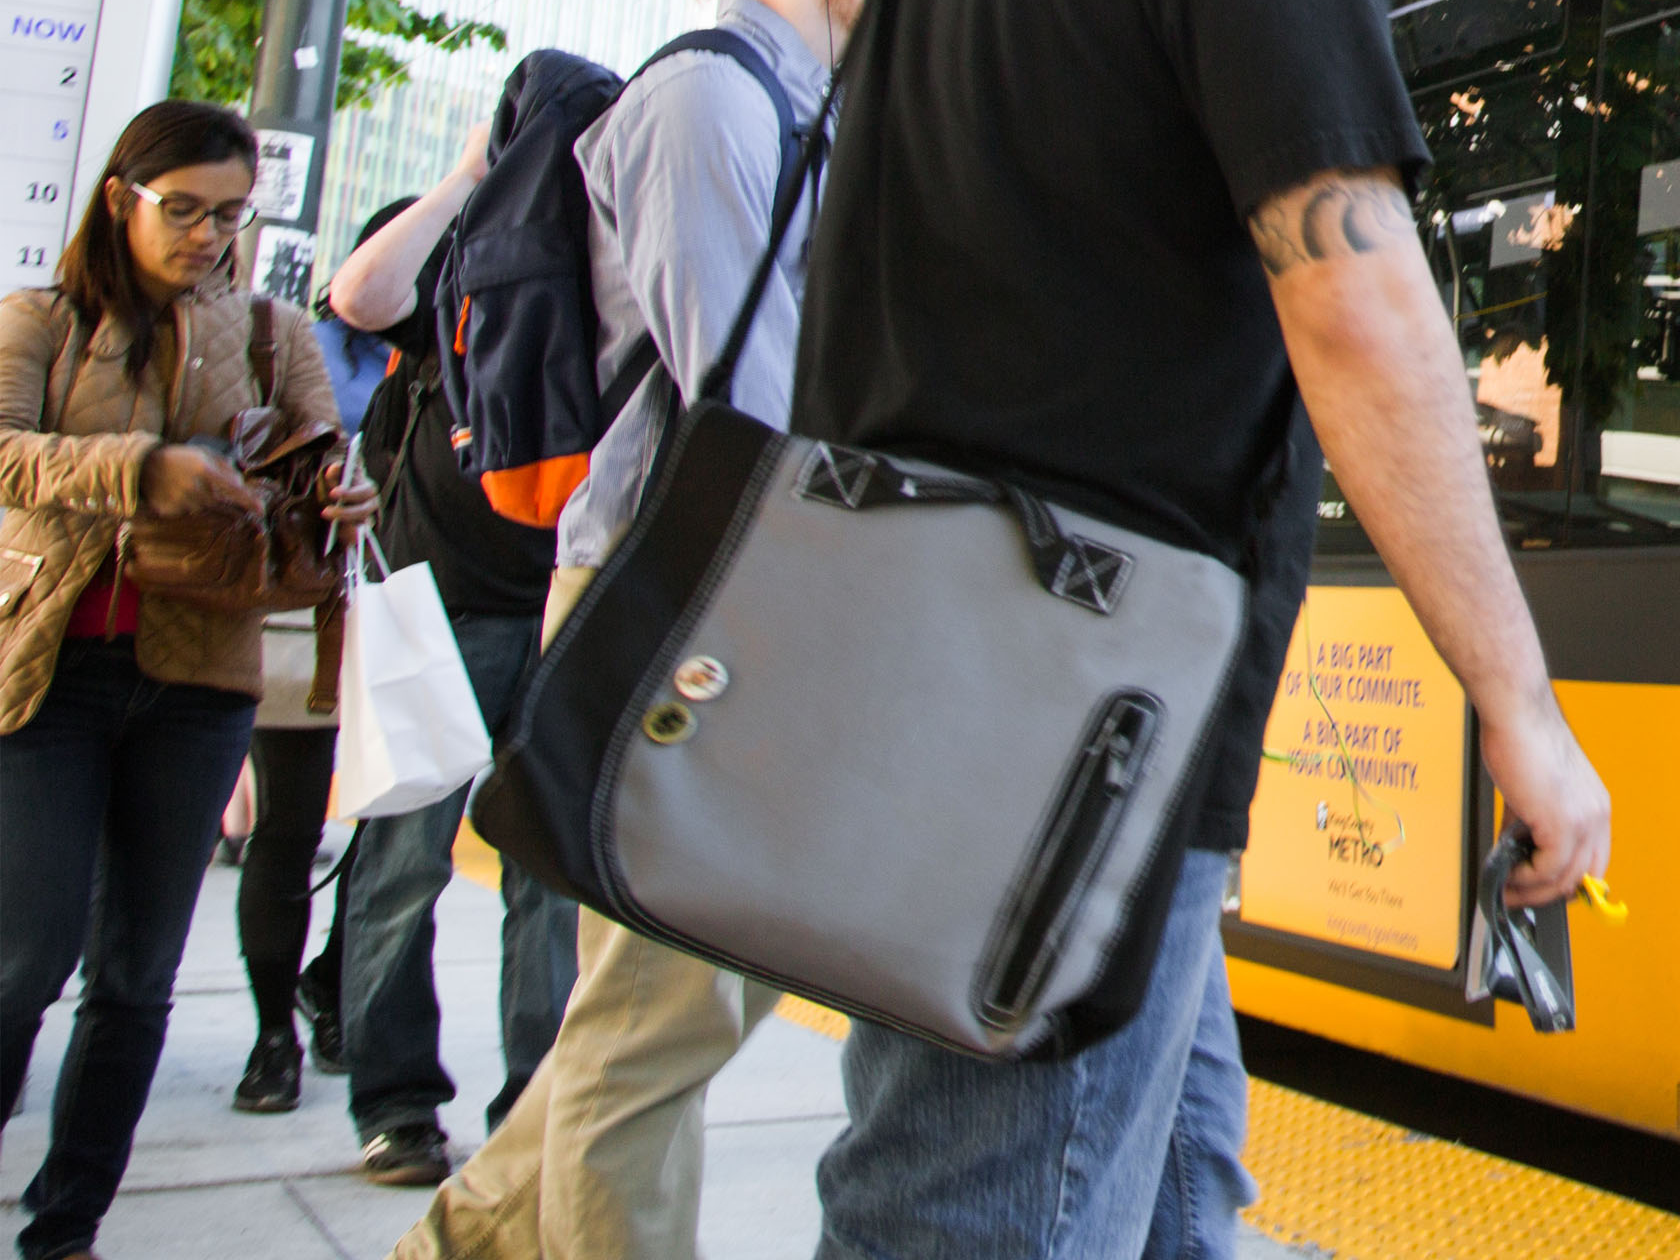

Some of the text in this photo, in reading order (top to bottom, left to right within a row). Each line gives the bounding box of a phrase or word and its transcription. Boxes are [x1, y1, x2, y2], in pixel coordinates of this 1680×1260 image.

[11, 14, 87, 42] NOW
[59, 66, 78, 87] 2
[53, 119, 70, 140] 5
[26, 181, 60, 203] 10
[16, 246, 49, 268] 11
[1316, 642, 1394, 671] A BIG PART
[1285, 671, 1302, 697] OF
[1346, 675, 1425, 707] COMMUTE.
[1302, 718, 1312, 744] A
[1344, 723, 1379, 752] PART
[1384, 726, 1403, 755] OF
[1328, 833, 1385, 868] METRO
